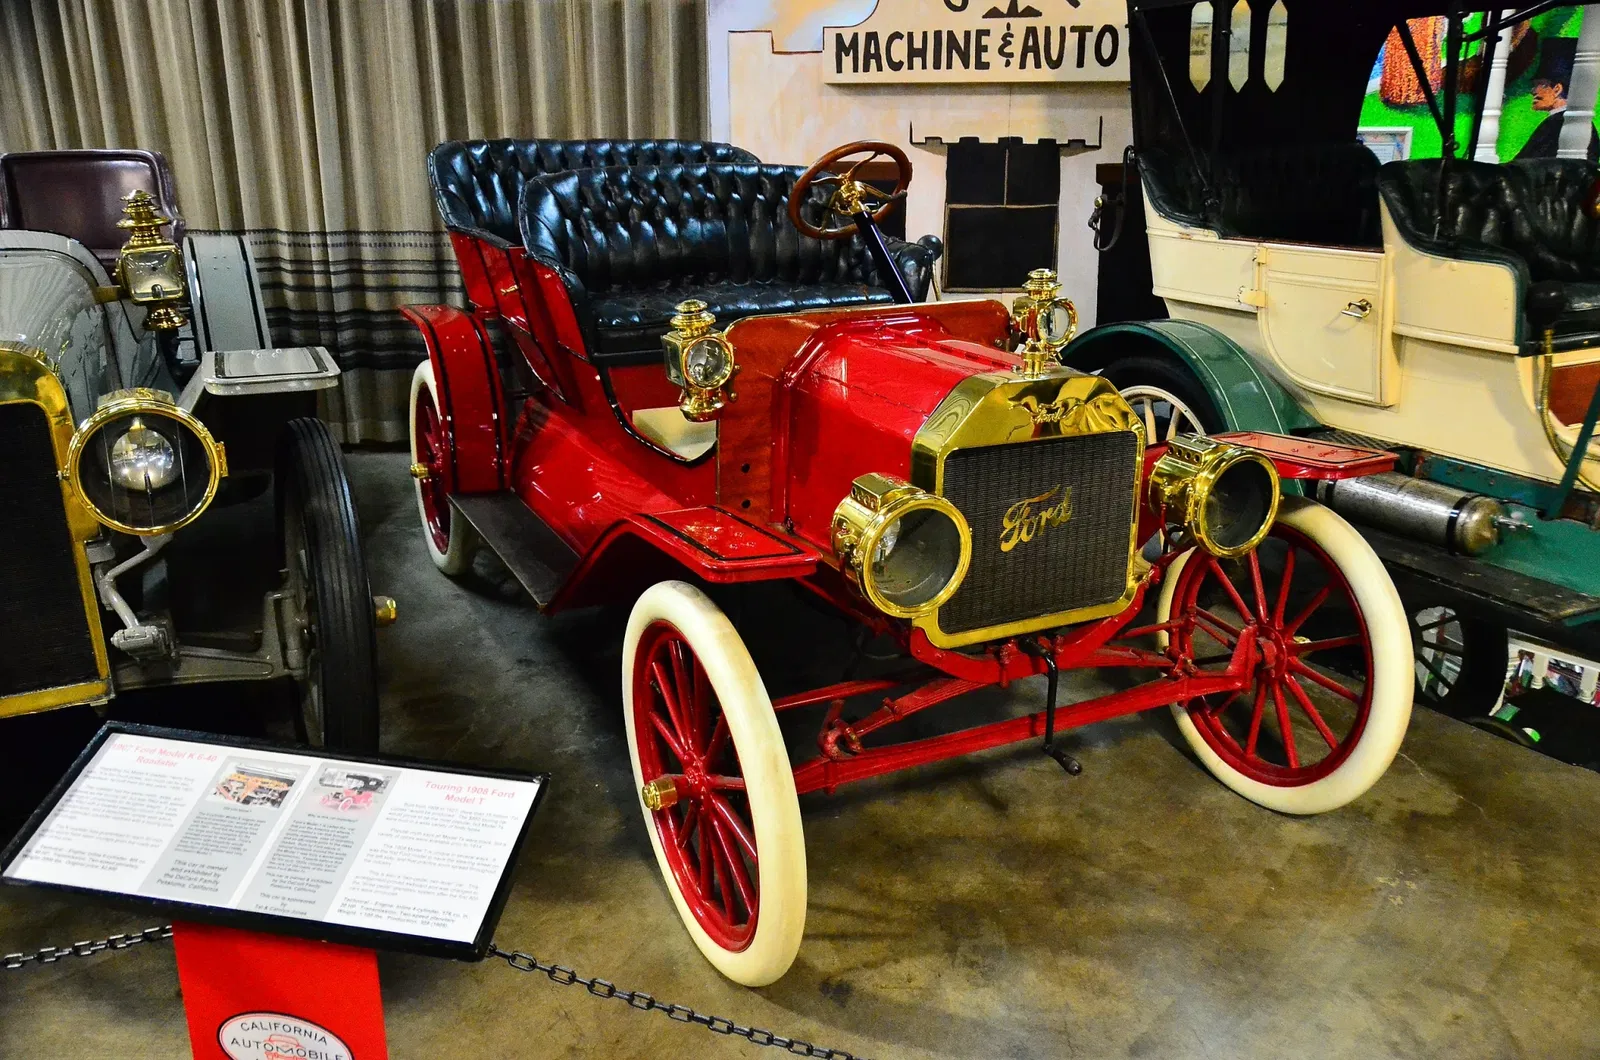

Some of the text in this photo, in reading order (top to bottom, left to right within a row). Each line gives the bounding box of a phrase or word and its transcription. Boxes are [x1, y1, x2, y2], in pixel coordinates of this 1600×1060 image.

[835, 22, 1119, 74] MACHINE & AUTO
[1000, 484, 1072, 552] Ford
[136, 755, 178, 768] Roadster
[158, 748, 185, 759] Model
[425, 780, 515, 799] Touring 1908 Ford
[444, 794, 486, 805] Model T
[240, 1021, 328, 1046] CALIFORNIA
[230, 1037, 344, 1060] AUTOMOBILE
